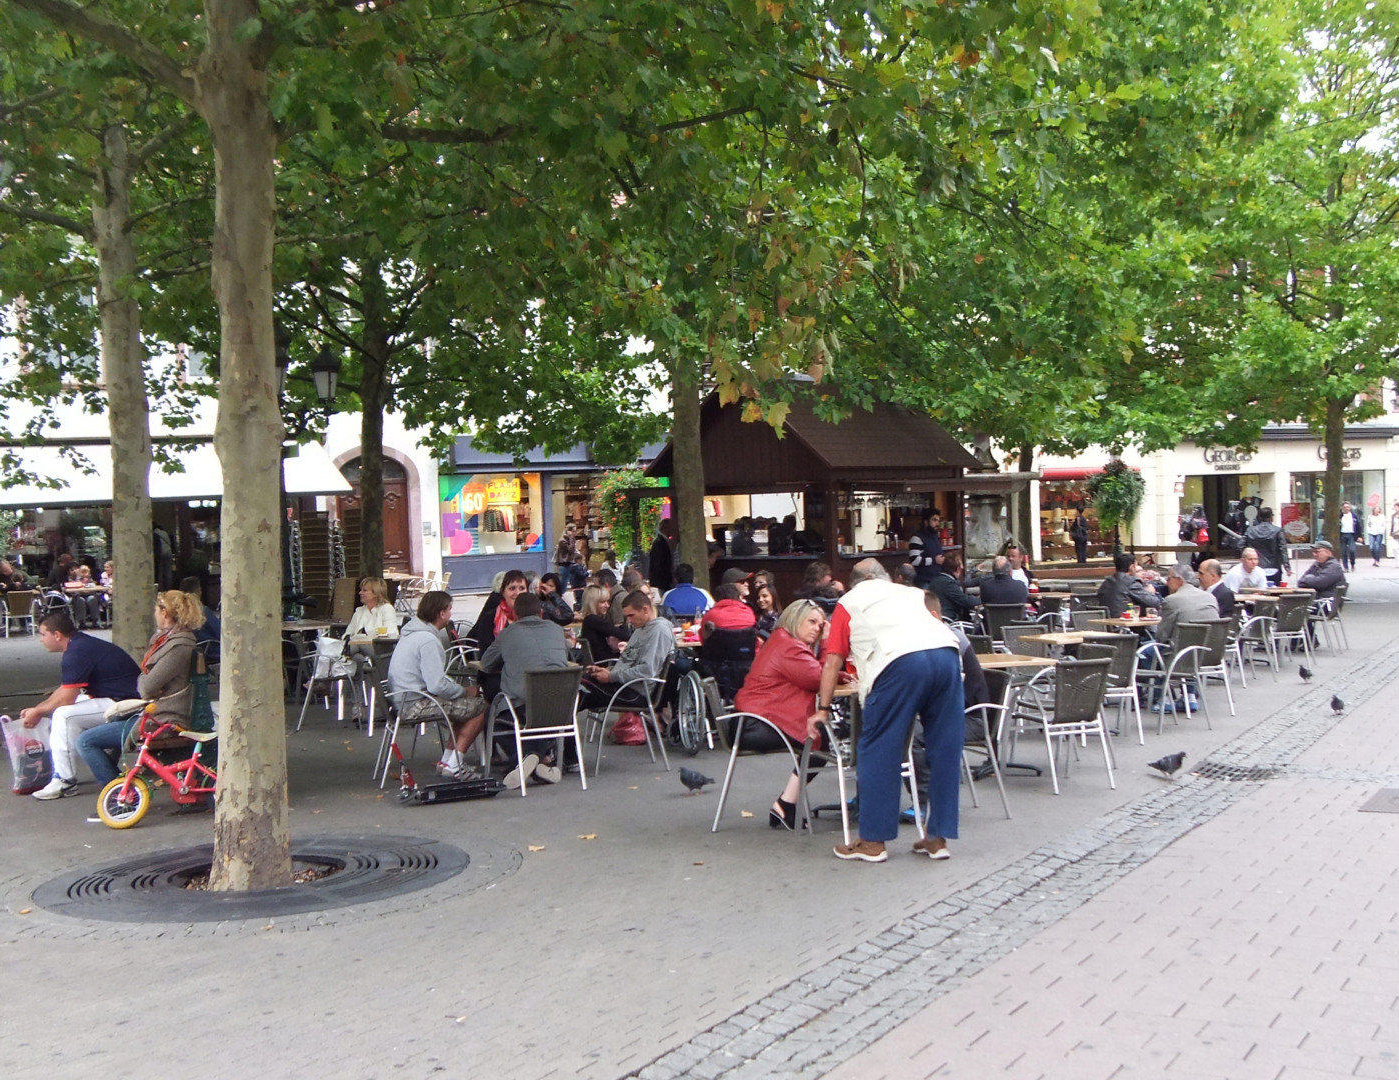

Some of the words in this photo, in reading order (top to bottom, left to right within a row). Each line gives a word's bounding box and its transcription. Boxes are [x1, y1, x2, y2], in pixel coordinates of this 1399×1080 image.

[1203, 446, 1253, 463] GEORGES
[487, 481, 518, 489] FLASH
[489, 491, 517, 499] DAY'Z
